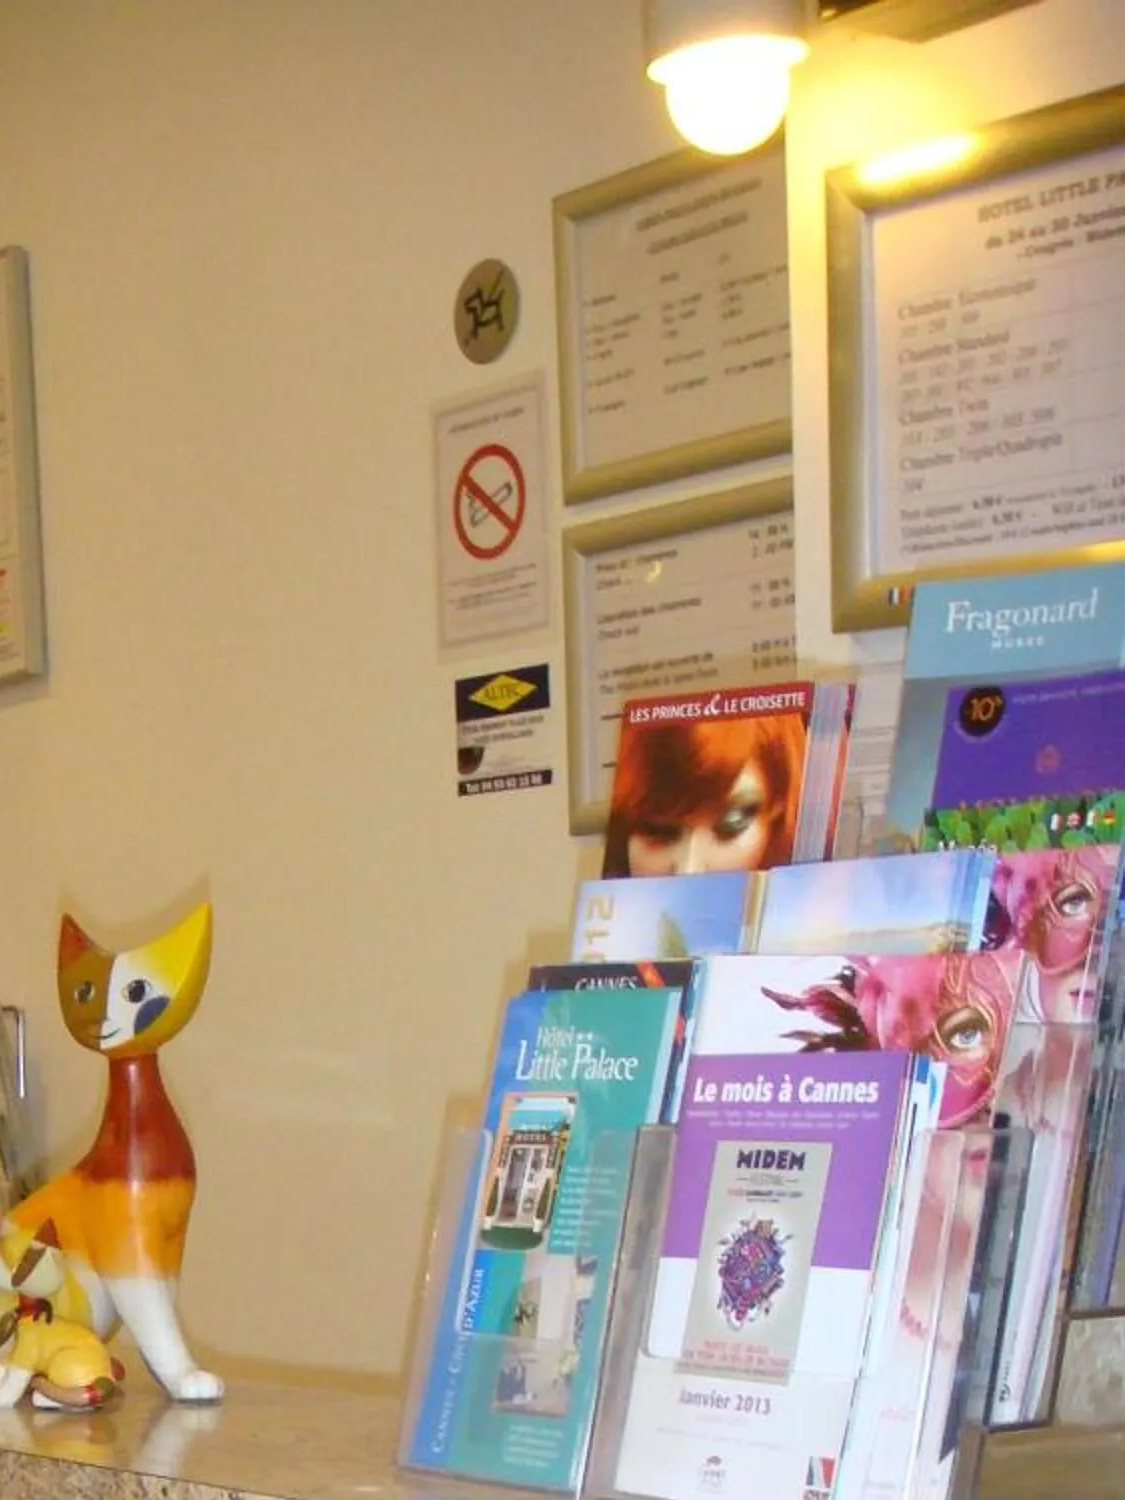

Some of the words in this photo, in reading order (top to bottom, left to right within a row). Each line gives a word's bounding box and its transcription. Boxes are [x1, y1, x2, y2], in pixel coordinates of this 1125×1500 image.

[1039, 177, 1100, 207] LITTLE
[945, 587, 1099, 635] Fragonard
[629, 706, 650, 724] LES
[651, 701, 702, 722] PRINCES
[723, 699, 739, 714] LE
[740, 691, 807, 712] CROISETTE
[536, 1025, 575, 1049] Hôtel
[515, 1039, 568, 1081] Little
[570, 1042, 639, 1081] Palace
[693, 1076, 718, 1103] Le
[721, 1074, 774, 1103] mois
[777, 1074, 793, 1103] à
[798, 1076, 880, 1103] Cannes
[736, 1148, 807, 1171] MIDEM
[734, 1393, 772, 1416] 2013
